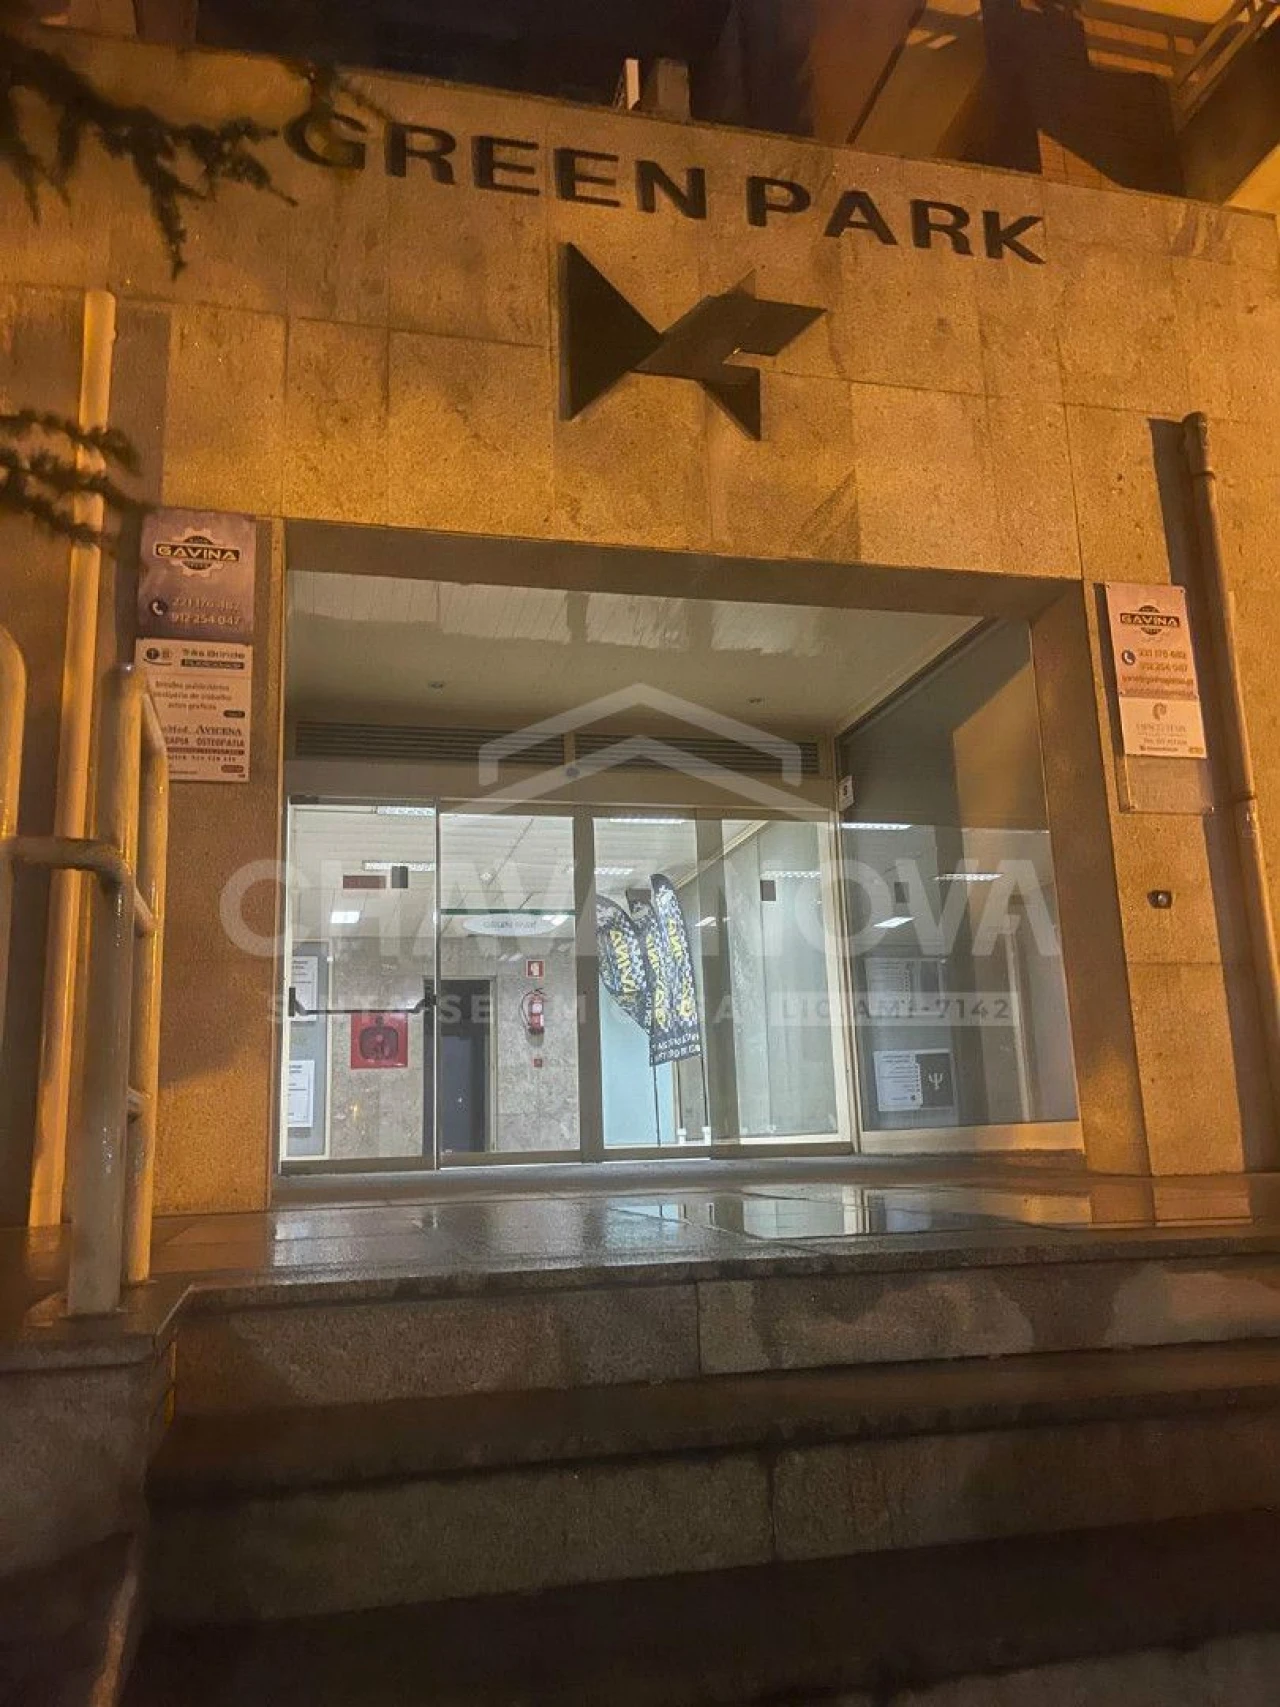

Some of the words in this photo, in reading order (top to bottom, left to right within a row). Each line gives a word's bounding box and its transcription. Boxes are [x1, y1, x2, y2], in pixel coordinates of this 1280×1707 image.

[283, 112, 706, 220] GREEN
[746, 176, 1046, 265] PARK
[157, 546, 238, 561] GAVINA
[1121, 615, 1179, 628] GAVINA
